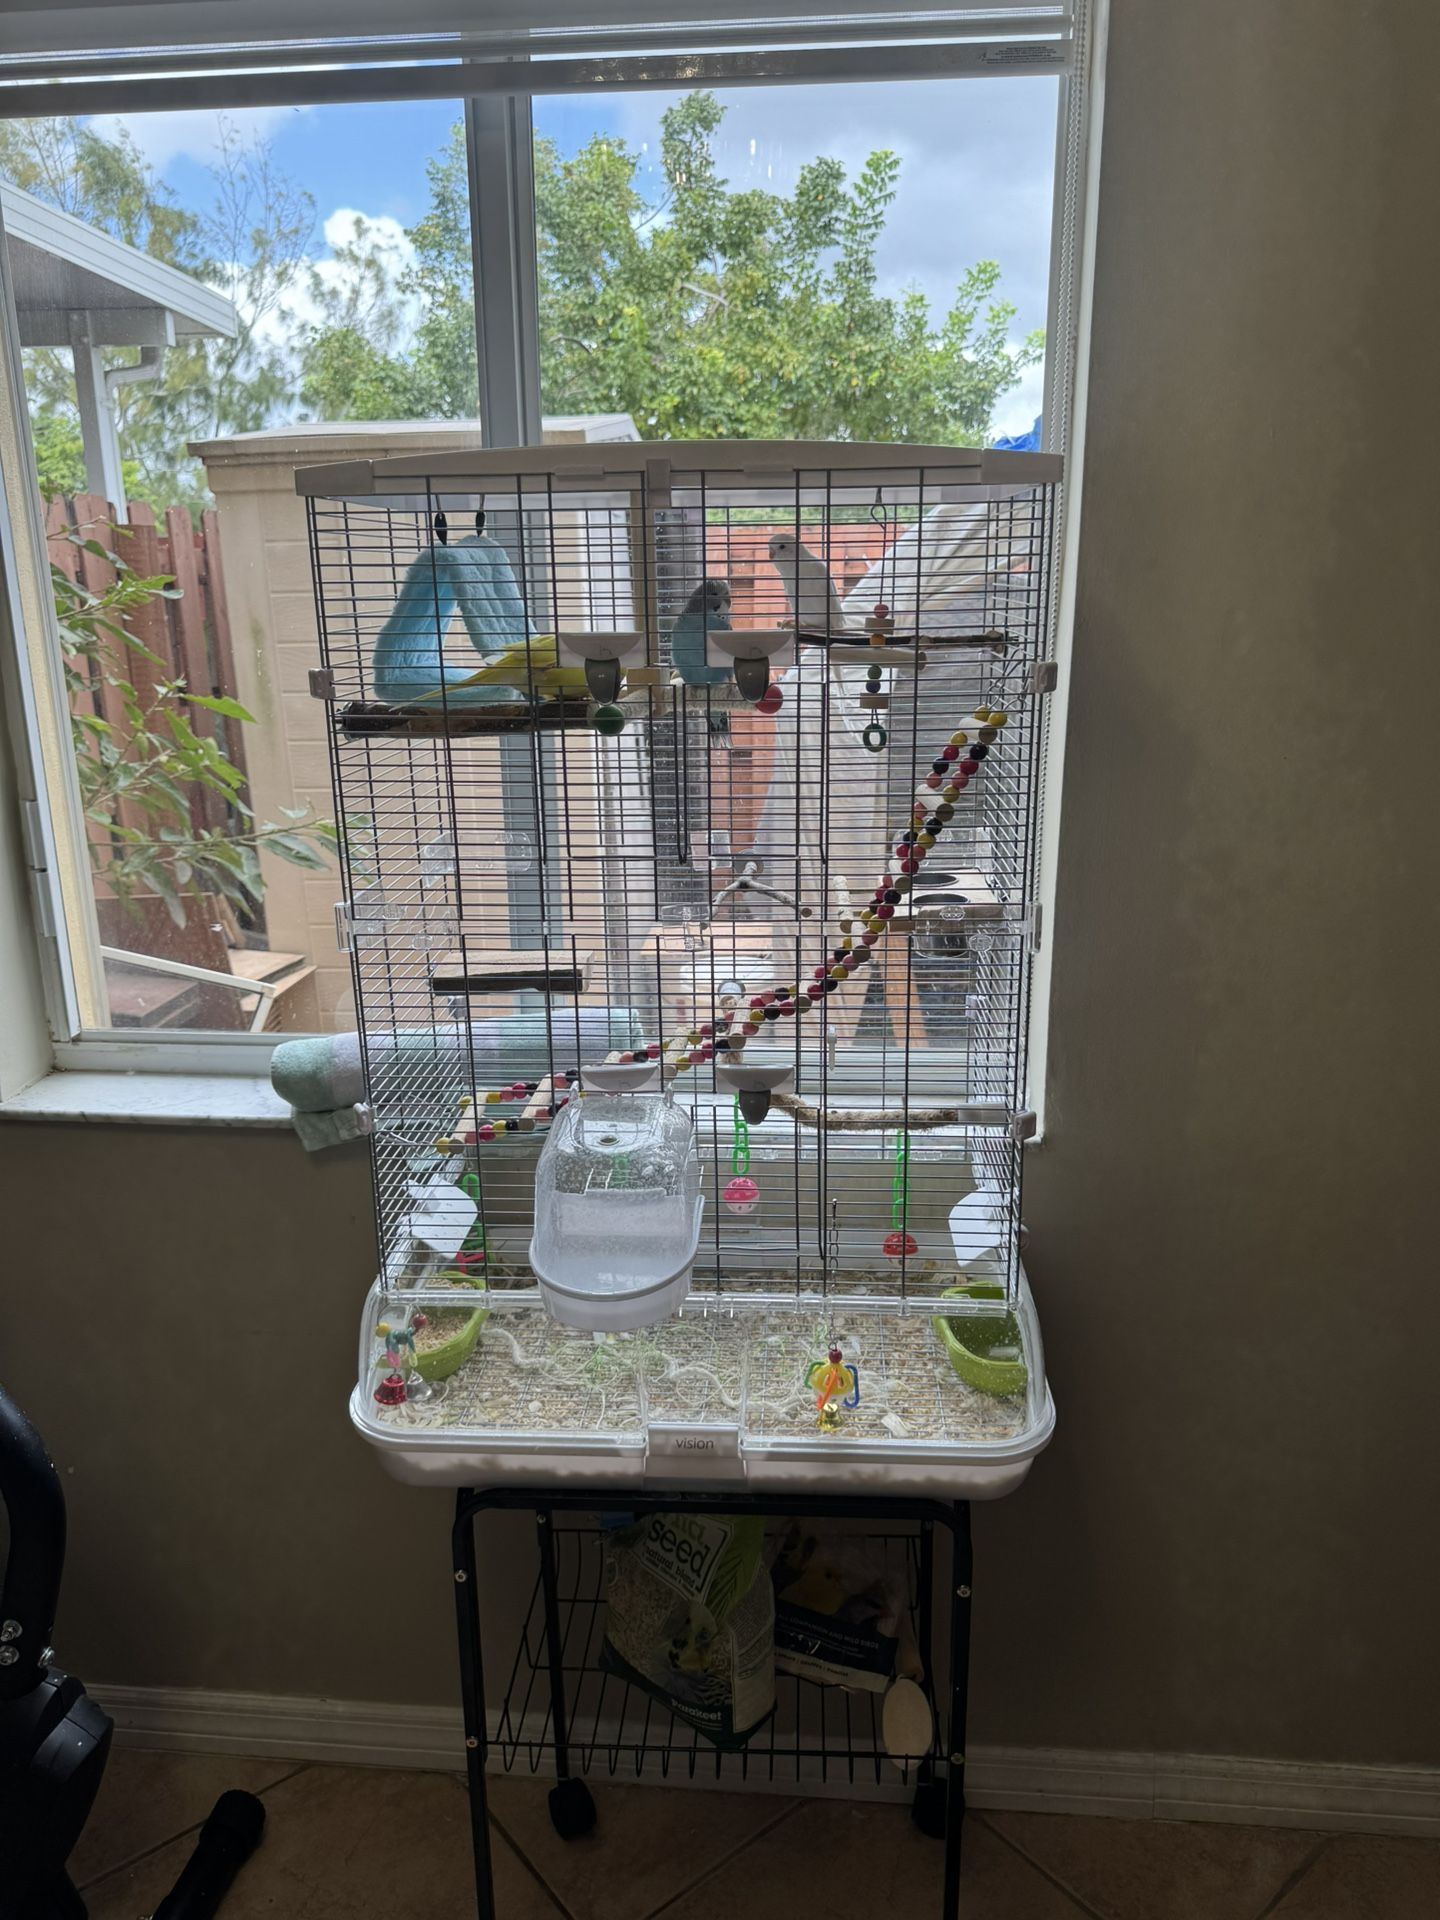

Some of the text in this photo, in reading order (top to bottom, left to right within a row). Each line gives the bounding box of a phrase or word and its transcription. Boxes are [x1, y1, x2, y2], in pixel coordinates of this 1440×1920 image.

[676, 1437, 714, 1449] vision
[647, 1519, 711, 1578] seed
[861, 1638, 880, 1650] BIRDS
[671, 1697, 723, 1721] Parakeet
